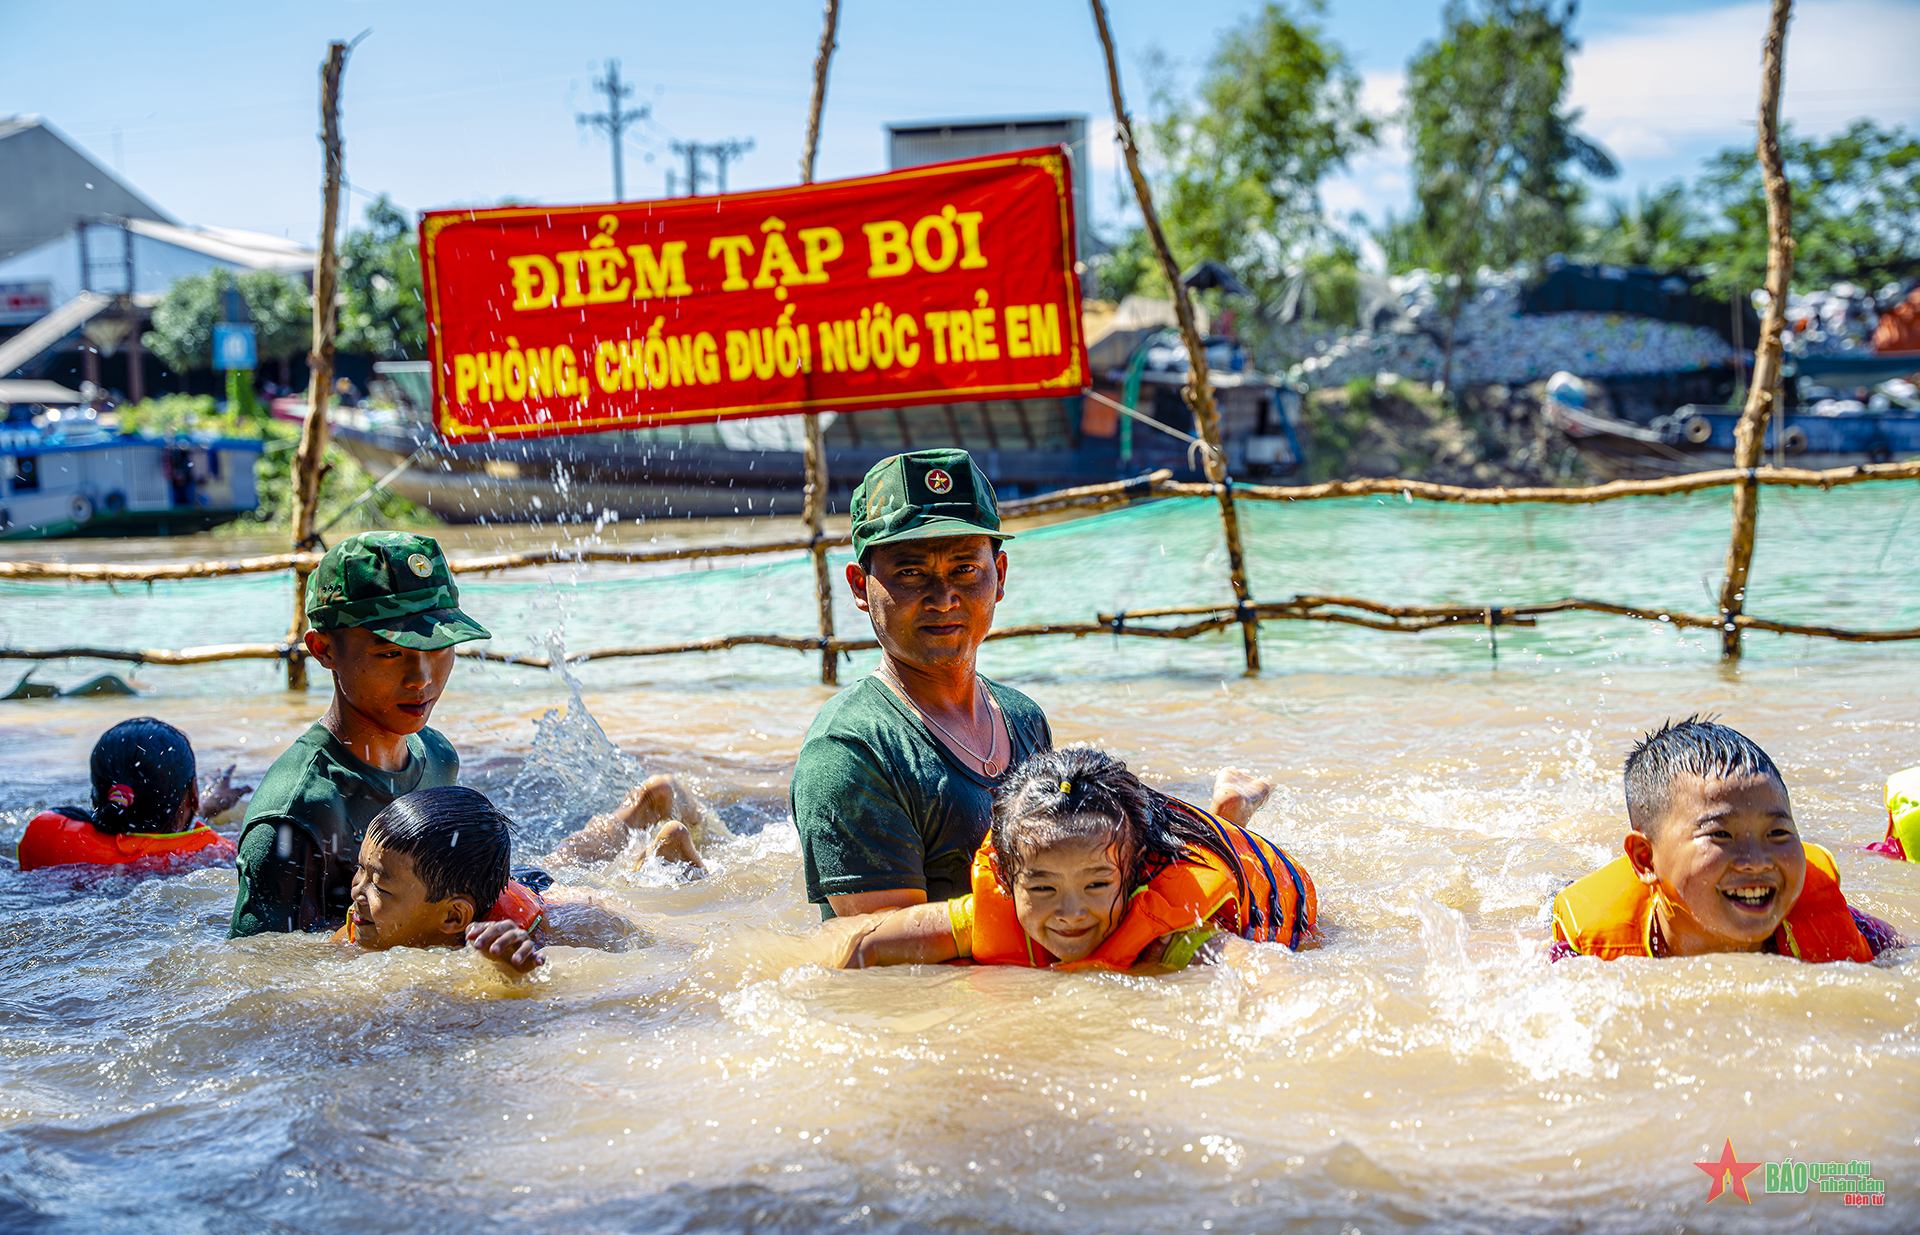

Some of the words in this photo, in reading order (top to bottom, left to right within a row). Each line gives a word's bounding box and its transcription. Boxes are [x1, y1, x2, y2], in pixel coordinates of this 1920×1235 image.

[507, 214, 694, 312] ĐIỂM
[707, 215, 844, 301] TẬP
[862, 203, 989, 279] BƠI
[453, 335, 590, 406] PHÒNG,
[594, 315, 722, 394] CHỐNG
[725, 302, 813, 382] ĐUỐI
[818, 302, 921, 374] NƯỚC
[924, 287, 1001, 365] TRẺ
[1003, 302, 1063, 359] EM
